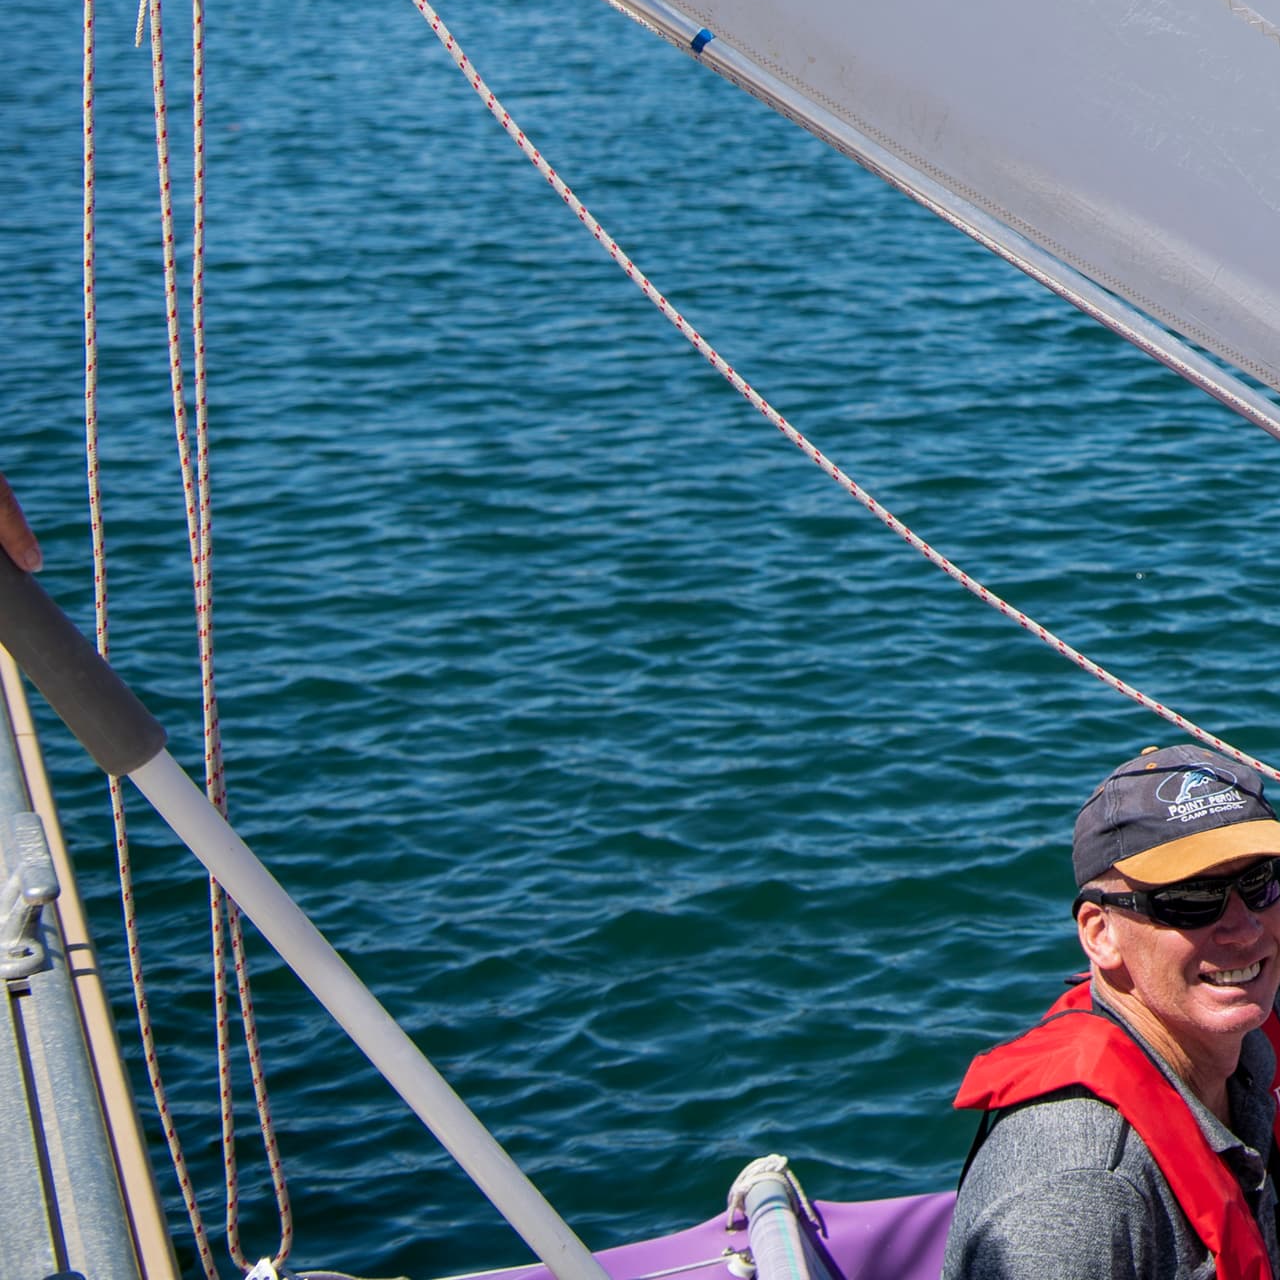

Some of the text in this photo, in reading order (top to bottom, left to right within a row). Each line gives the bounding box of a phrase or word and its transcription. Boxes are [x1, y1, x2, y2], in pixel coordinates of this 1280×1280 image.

[1168, 789, 1241, 817] POINT PERON
[1181, 804, 1243, 822] CAMP SCHOOL
